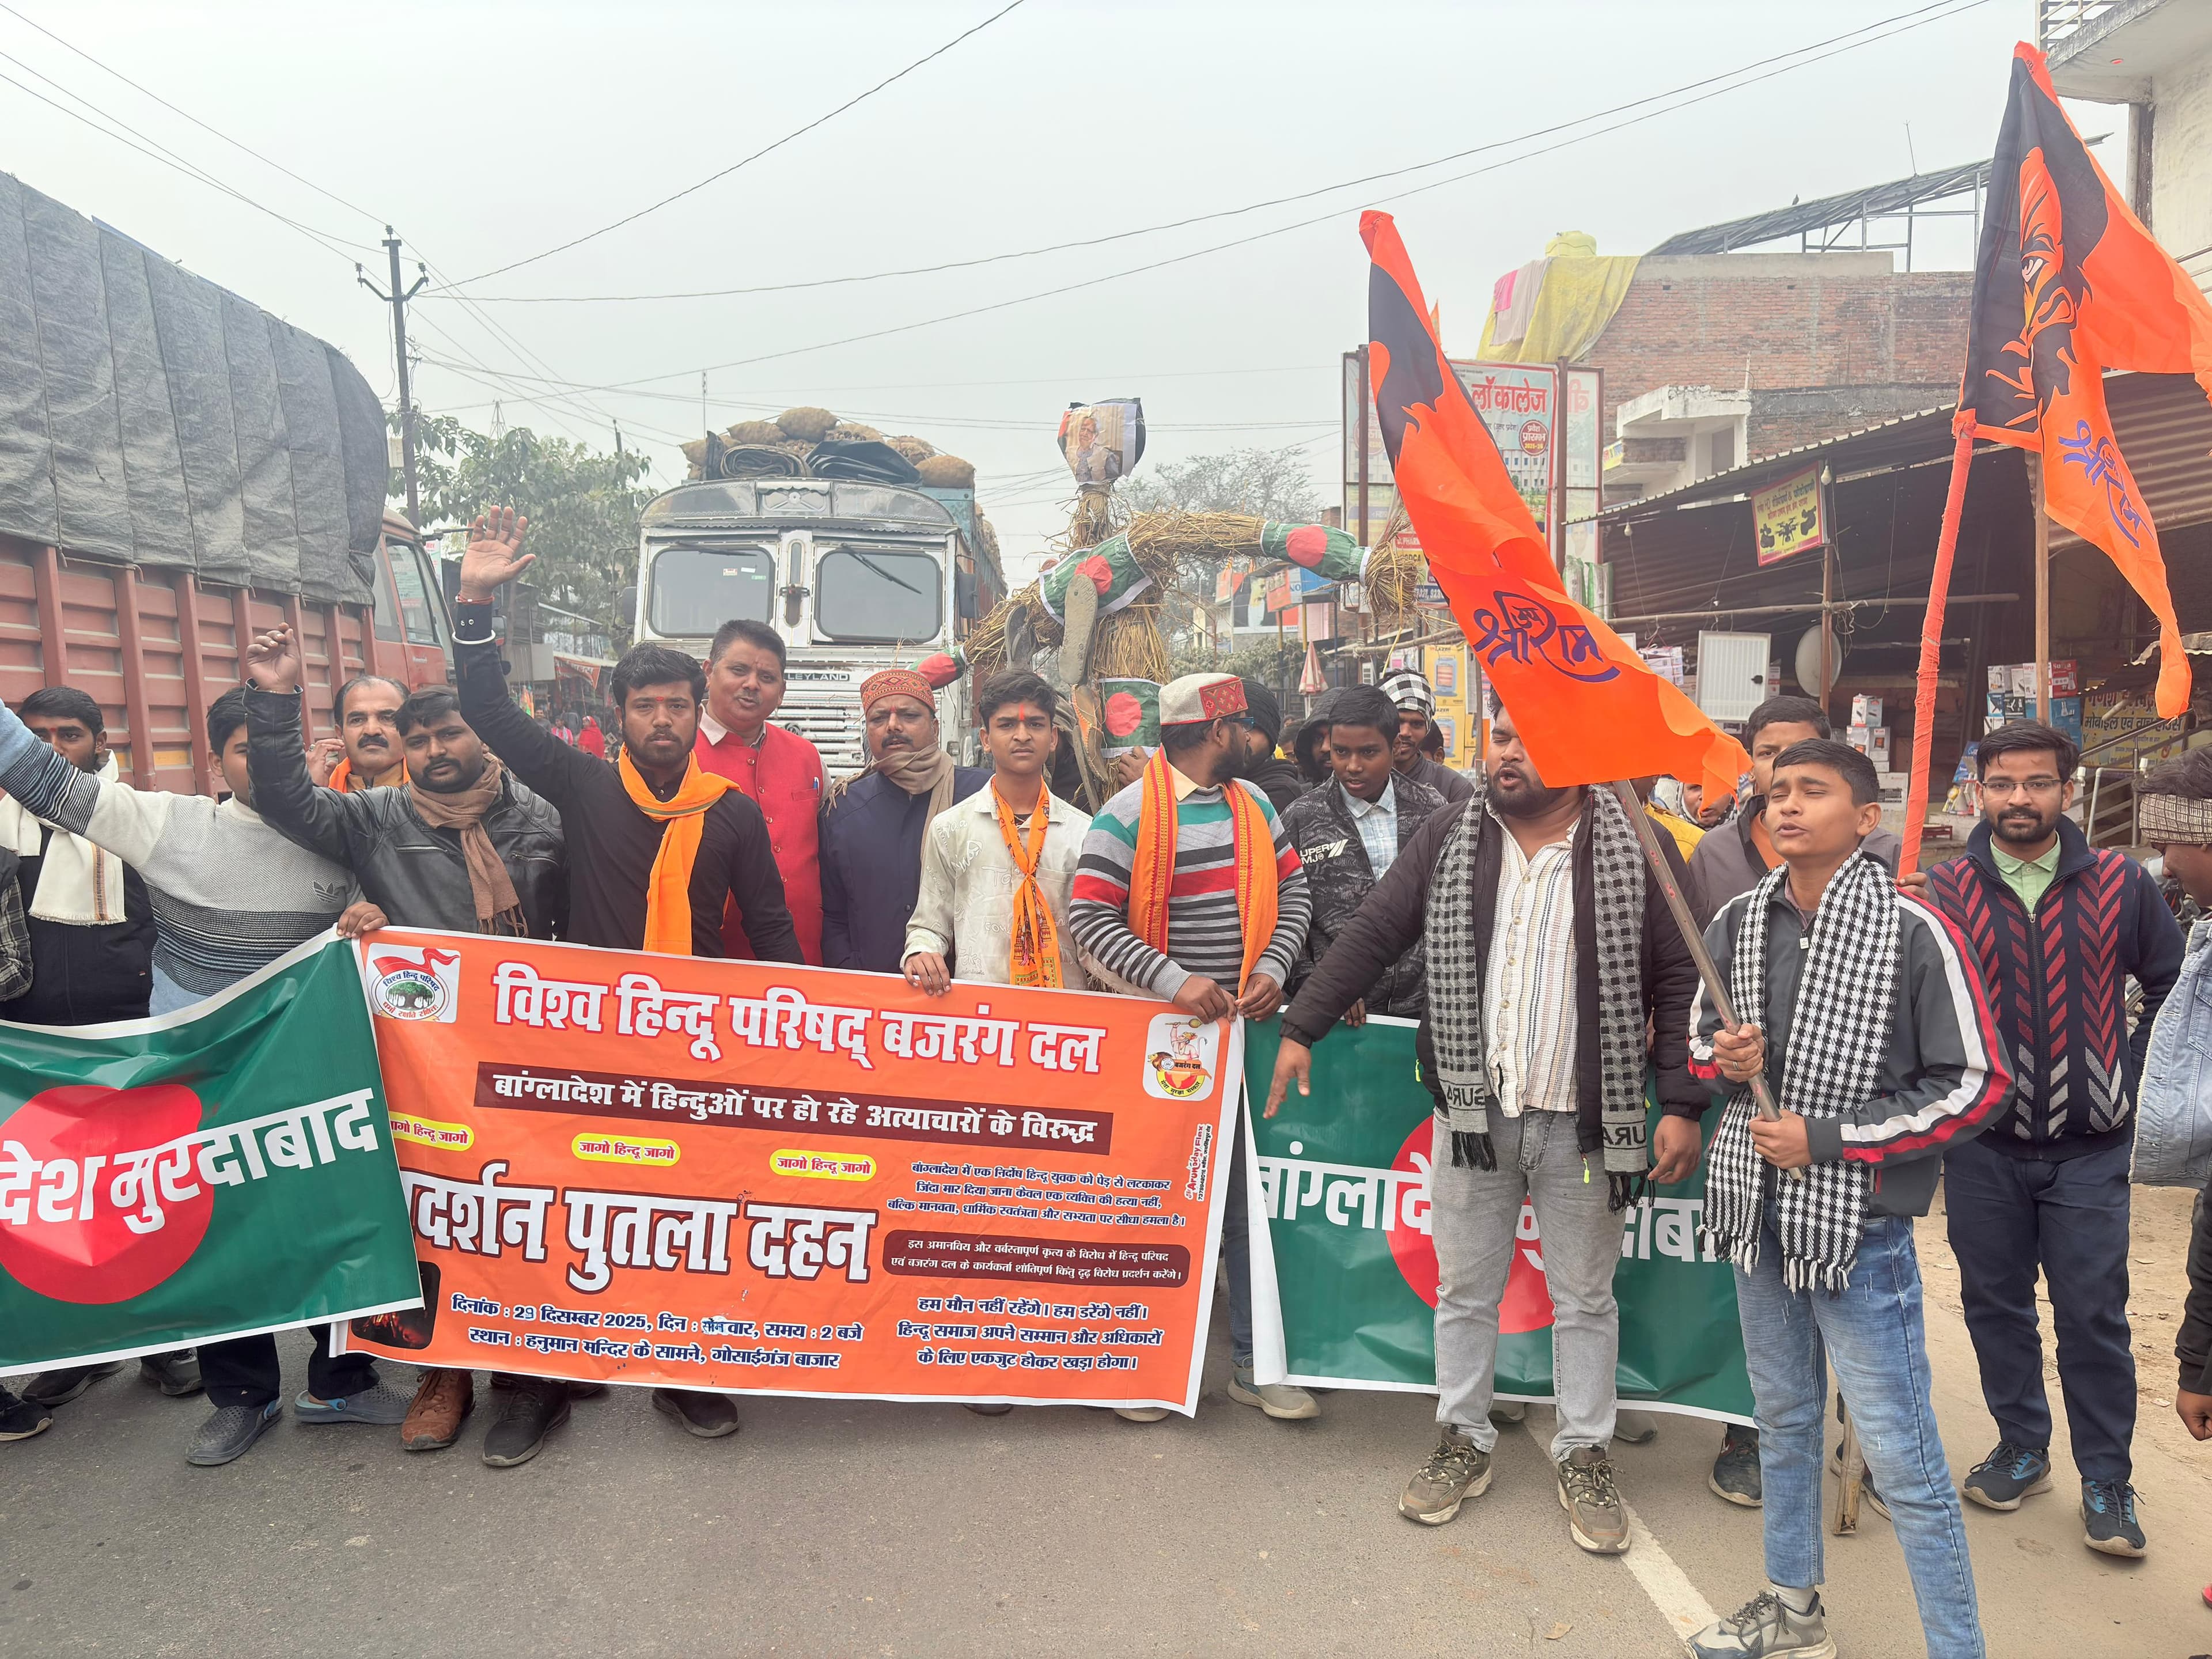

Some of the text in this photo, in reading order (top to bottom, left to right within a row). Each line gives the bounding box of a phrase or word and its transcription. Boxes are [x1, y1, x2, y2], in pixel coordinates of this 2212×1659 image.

[1494, 377, 1547, 414] कालेज
[787, 673, 849, 681] LEYLAND
[1300, 843, 1330, 857] UPER
[382, 974, 402, 987] विश्व
[403, 971, 418, 981] हिन्दू
[493, 961, 1107, 1074] विश्व हिन्दू परिषद् बजरंग दल
[1175, 1061, 1191, 1069] बजरंग
[493, 1070, 1098, 1145] बांग्लादेश में हिन्दुओं पर हो रहे अत्याचारों के विरुद्ध
[391, 1120, 468, 1144] ागो हिन्दू जागो
[110, 1087, 380, 1234] मुरदाबाद
[579, 1140, 675, 1160] जागो हिन्दू जागो
[777, 1156, 872, 1175] जागो हिन्दू जागो
[912, 1162, 1171, 1190] बांग्लादेश में एक निर्दोष हिन्दू युवक को पेड़ से लटकाकर
[916, 1181, 1161, 1209] जिंदा मार दिया जाना केवल एक व्यक्ति की हत्या नहीं,
[1257, 1141, 1433, 1235] बांग्लादे
[888, 1198, 915, 1210] बल्कि
[919, 1202, 959, 1214] मानवता,
[963, 1203, 996, 1215] धार्मिक
[1041, 1207, 1060, 1219] और
[1062, 1211, 1096, 1222] सभ्यता
[1100, 1215, 1112, 1224] पर
[1116, 1214, 1139, 1225] सीधा
[1142, 1216, 1169, 1225] हमला
[402, 1161, 879, 1294] दर्शन पुतला दहन
[908, 1240, 923, 1249] इस
[974, 1241, 991, 1253] और
[1042, 1247, 1063, 1258] कृत्य
[1066, 1248, 1076, 1258] के
[1079, 1248, 1105, 1260] विरोध
[1108, 1250, 1118, 1260] में
[1119, 1250, 1138, 1262] हिन्दू
[1141, 1251, 1169, 1262] परिषद
[891, 1256, 906, 1266] एवं
[908, 1258, 938, 1268] बजरंग
[941, 1260, 956, 1269] दल
[960, 1259, 969, 1270] के
[972, 1261, 1012, 1272] कार्यकर्ता
[1016, 1262, 1052, 1276] शांतिपूर्ण
[1055, 1265, 1075, 1278] किंतु
[1094, 1267, 1119, 1278] विरोध
[1122, 1268, 1150, 1279] प्रदर्शन
[452, 1294, 499, 1315] दिनांक
[541, 1305, 600, 1325] दिसम्बर
[605, 1314, 652, 1331] 2025,
[658, 1313, 687, 1331] दिन
[764, 1324, 806, 1338] समय
[821, 1327, 832, 1339] 2
[837, 1324, 863, 1339] बजे
[919, 1298, 942, 1310] हम
[946, 1296, 975, 1312] मौन
[979, 1298, 1006, 1312] नहीं
[1053, 1305, 1076, 1317] हम
[1080, 1304, 1111, 1319] डरेंगे
[898, 1321, 1163, 1344] हिन्दू समाज अपने सम्मान और अधिकारों
[469, 1328, 840, 1367] स्थान हनुमान मन्दिर के सामने, गोसाईगंज बाजार
[918, 1347, 934, 1363] के
[938, 1349, 967, 1363] लिए
[971, 1353, 1018, 1368] एकजुट
[1021, 1352, 1059, 1368] होकर
[1063, 1357, 1093, 1370] खड़ा
